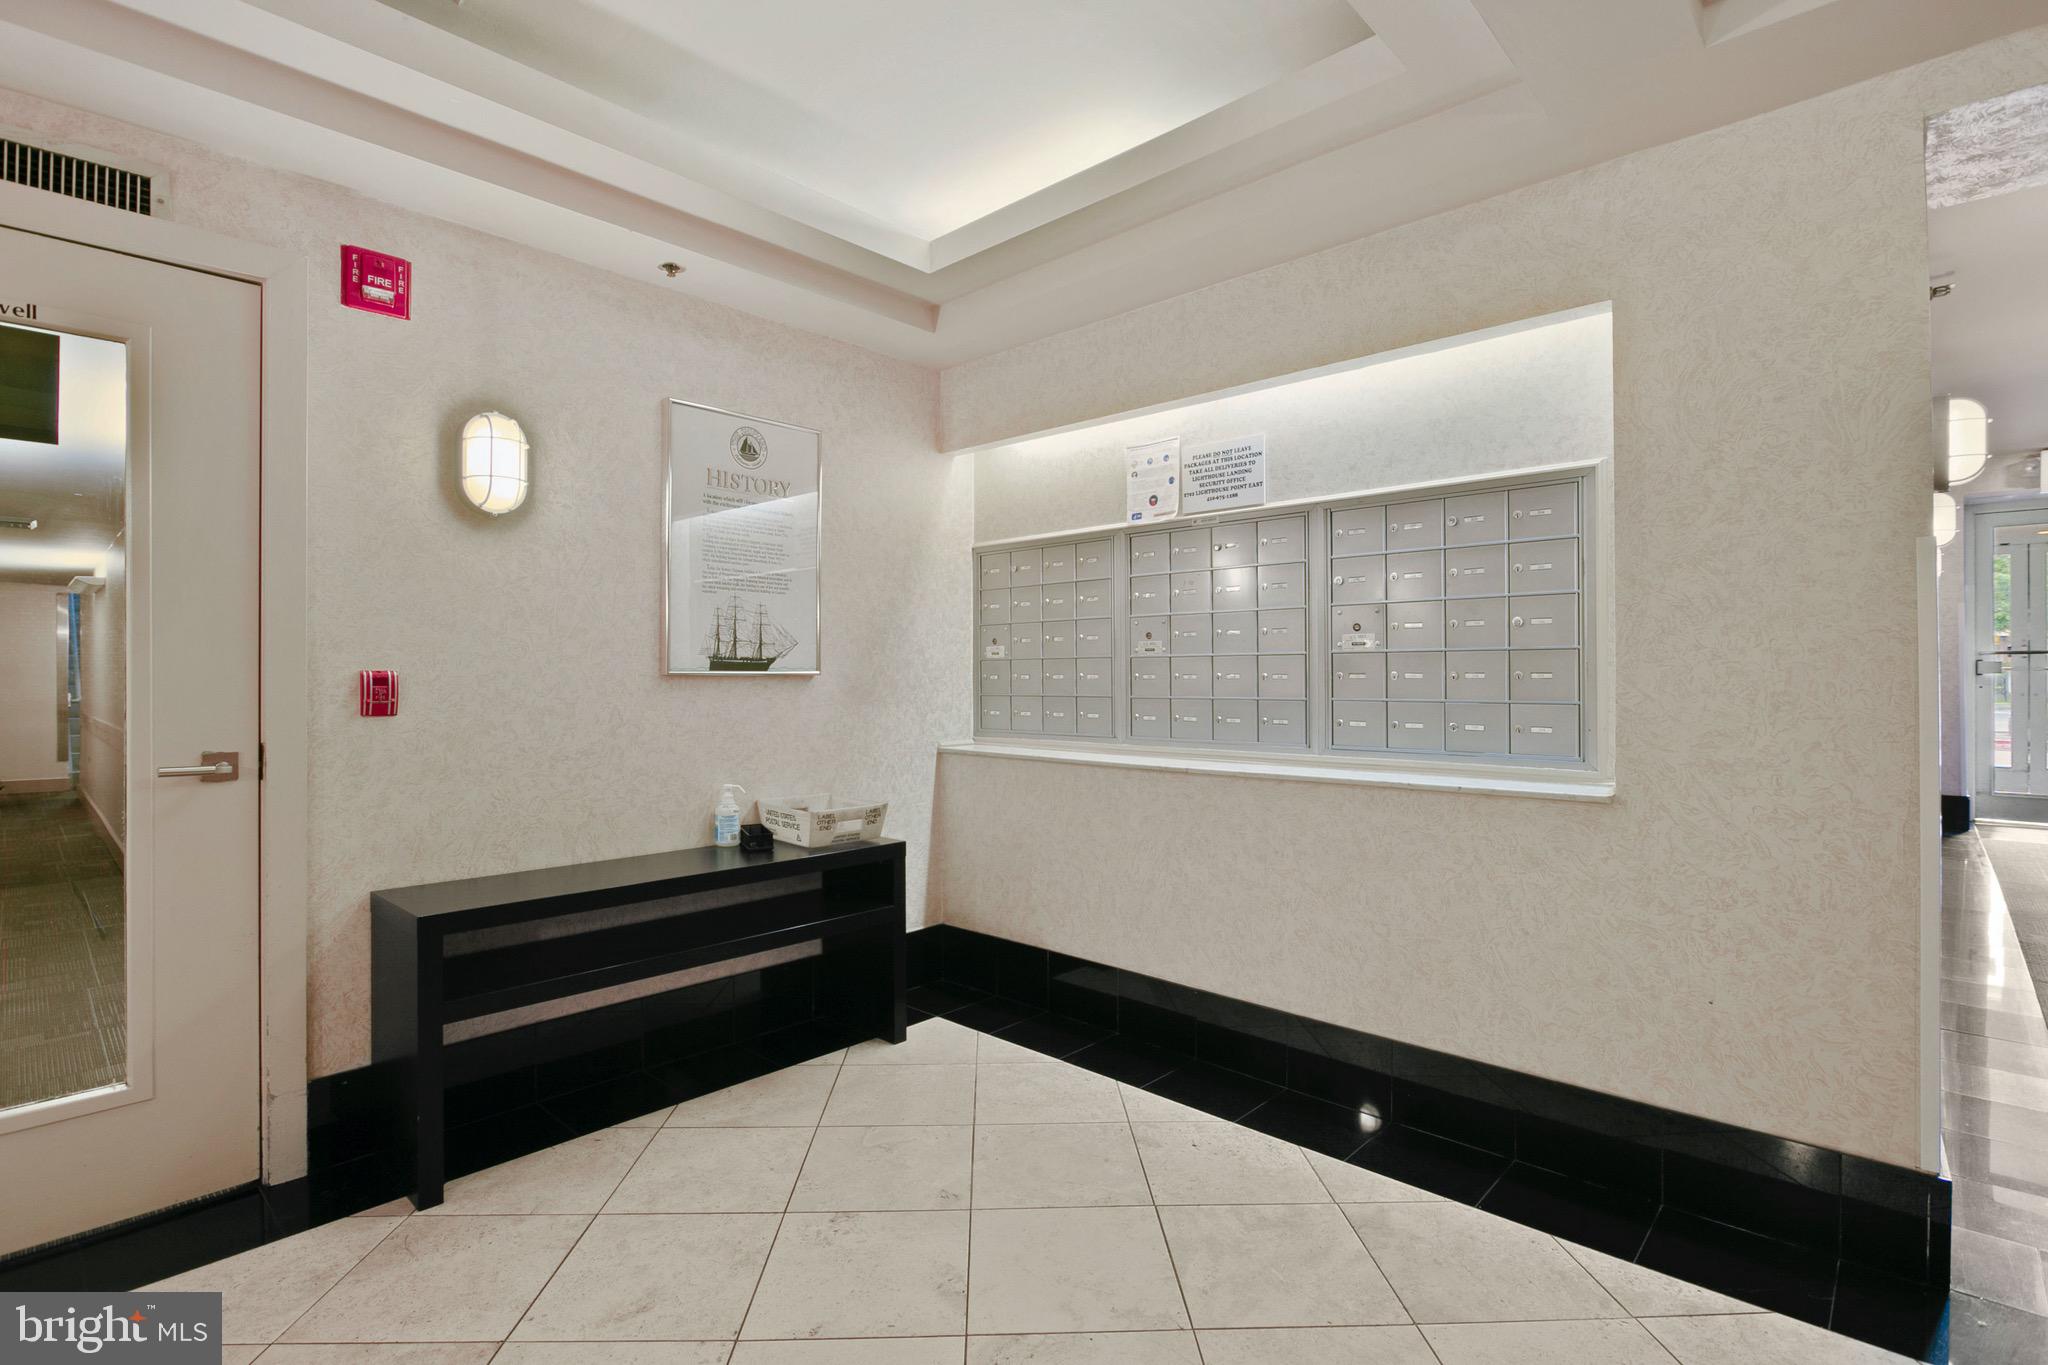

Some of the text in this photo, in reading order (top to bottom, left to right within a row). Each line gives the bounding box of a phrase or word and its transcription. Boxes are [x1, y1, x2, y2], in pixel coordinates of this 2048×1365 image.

[352, 254, 360, 283] FIRE
[367, 274, 392, 288] FIRE
[1184, 459, 1211, 469] PACKAGES
[1234, 451, 1263, 460] LOCATION
[1192, 452, 1211, 461] PLEASE
[1234, 445, 1252, 454] LEAVE
[1189, 467, 1203, 475] TAKE
[1215, 461, 1247, 471] DELIVERIES
[1192, 467, 1253, 482] LIGHTHOUSE LANDING
[706, 466, 791, 497] HISTORY
[1199, 476, 1246, 488] SECURITY OFFICE
[1195, 485, 1230, 496] LIGHTHOUSE
[1230, 483, 1247, 491] POINT
[864, 812, 882, 821] OTHER
[865, 807, 881, 815] LABEL
